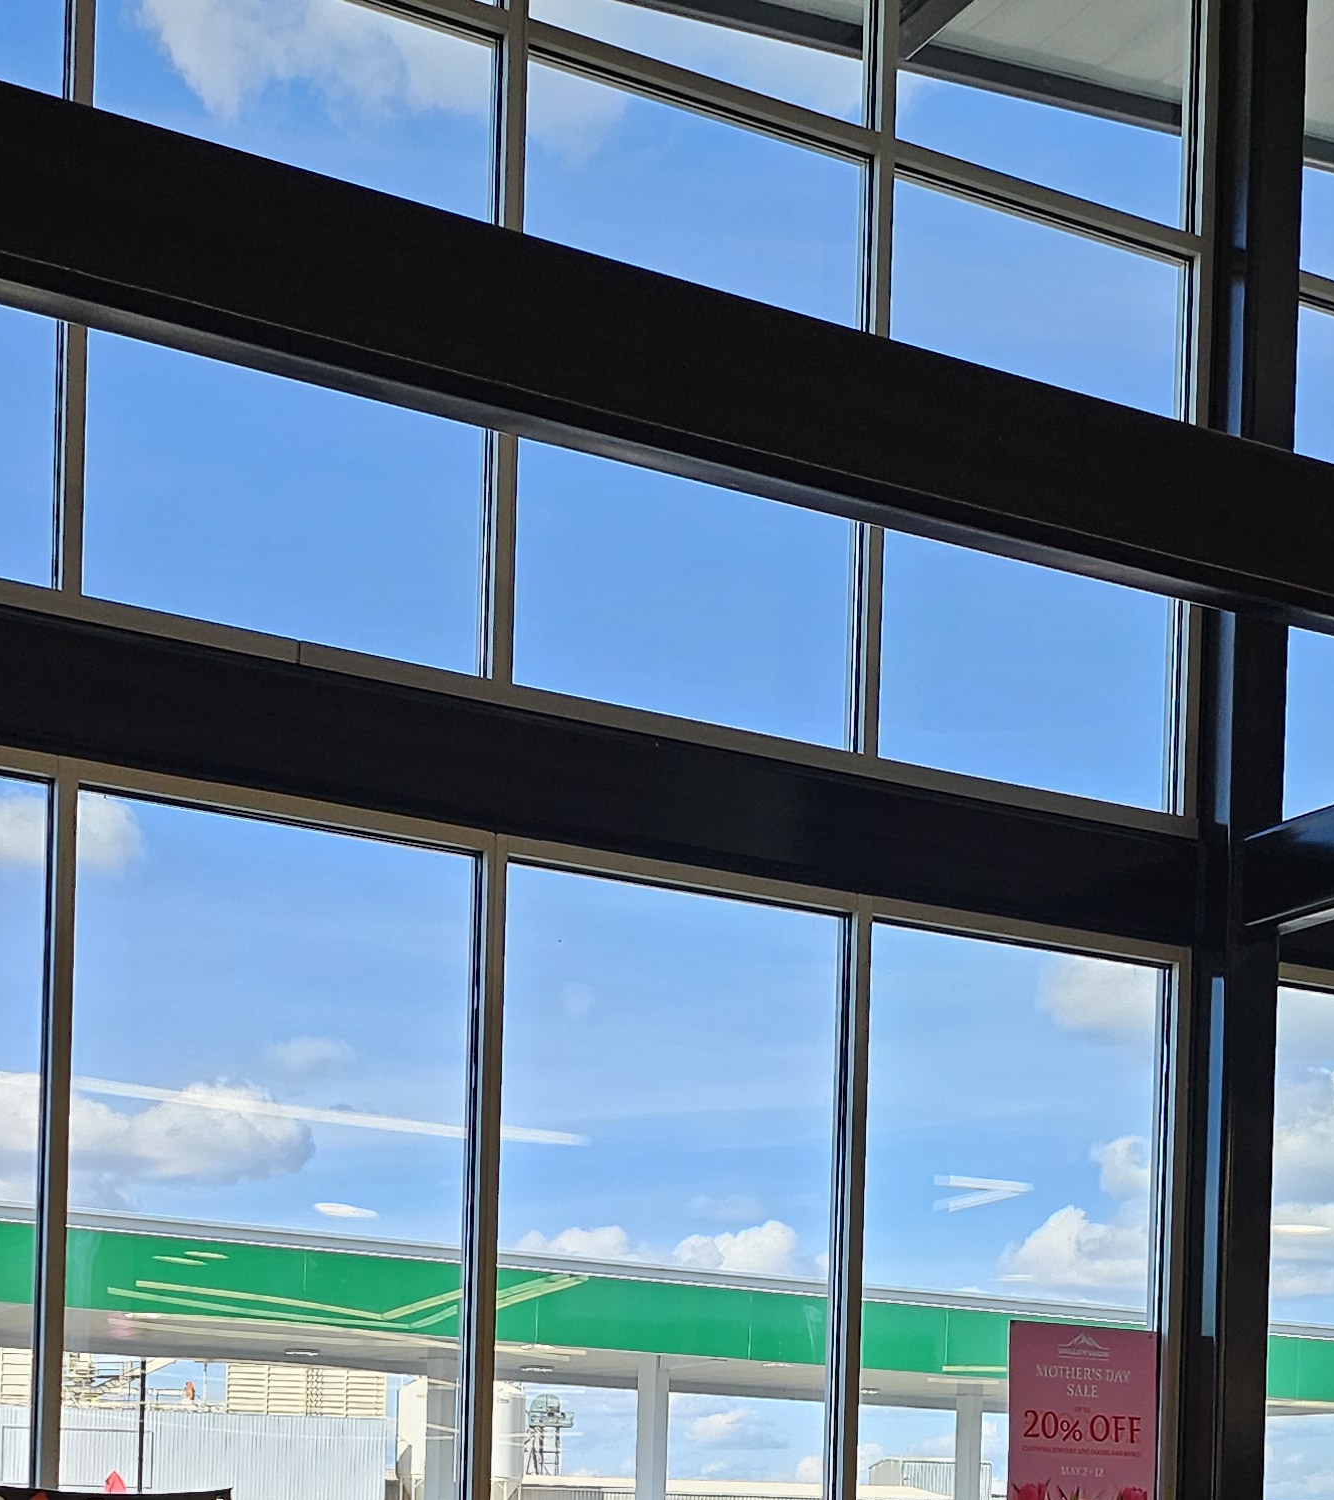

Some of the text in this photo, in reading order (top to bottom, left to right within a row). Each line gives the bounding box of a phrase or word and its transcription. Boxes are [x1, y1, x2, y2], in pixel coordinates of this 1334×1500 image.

[1036, 1364, 1131, 1382] MOTHER'S DAY
[1067, 1384, 1098, 1398] SALE
[1023, 1410, 1141, 1443] 20% OFF
[1060, 1466, 1079, 1475] MAY
[1081, 1467, 1087, 1475] 2
[1094, 1468, 1104, 1477] 12
